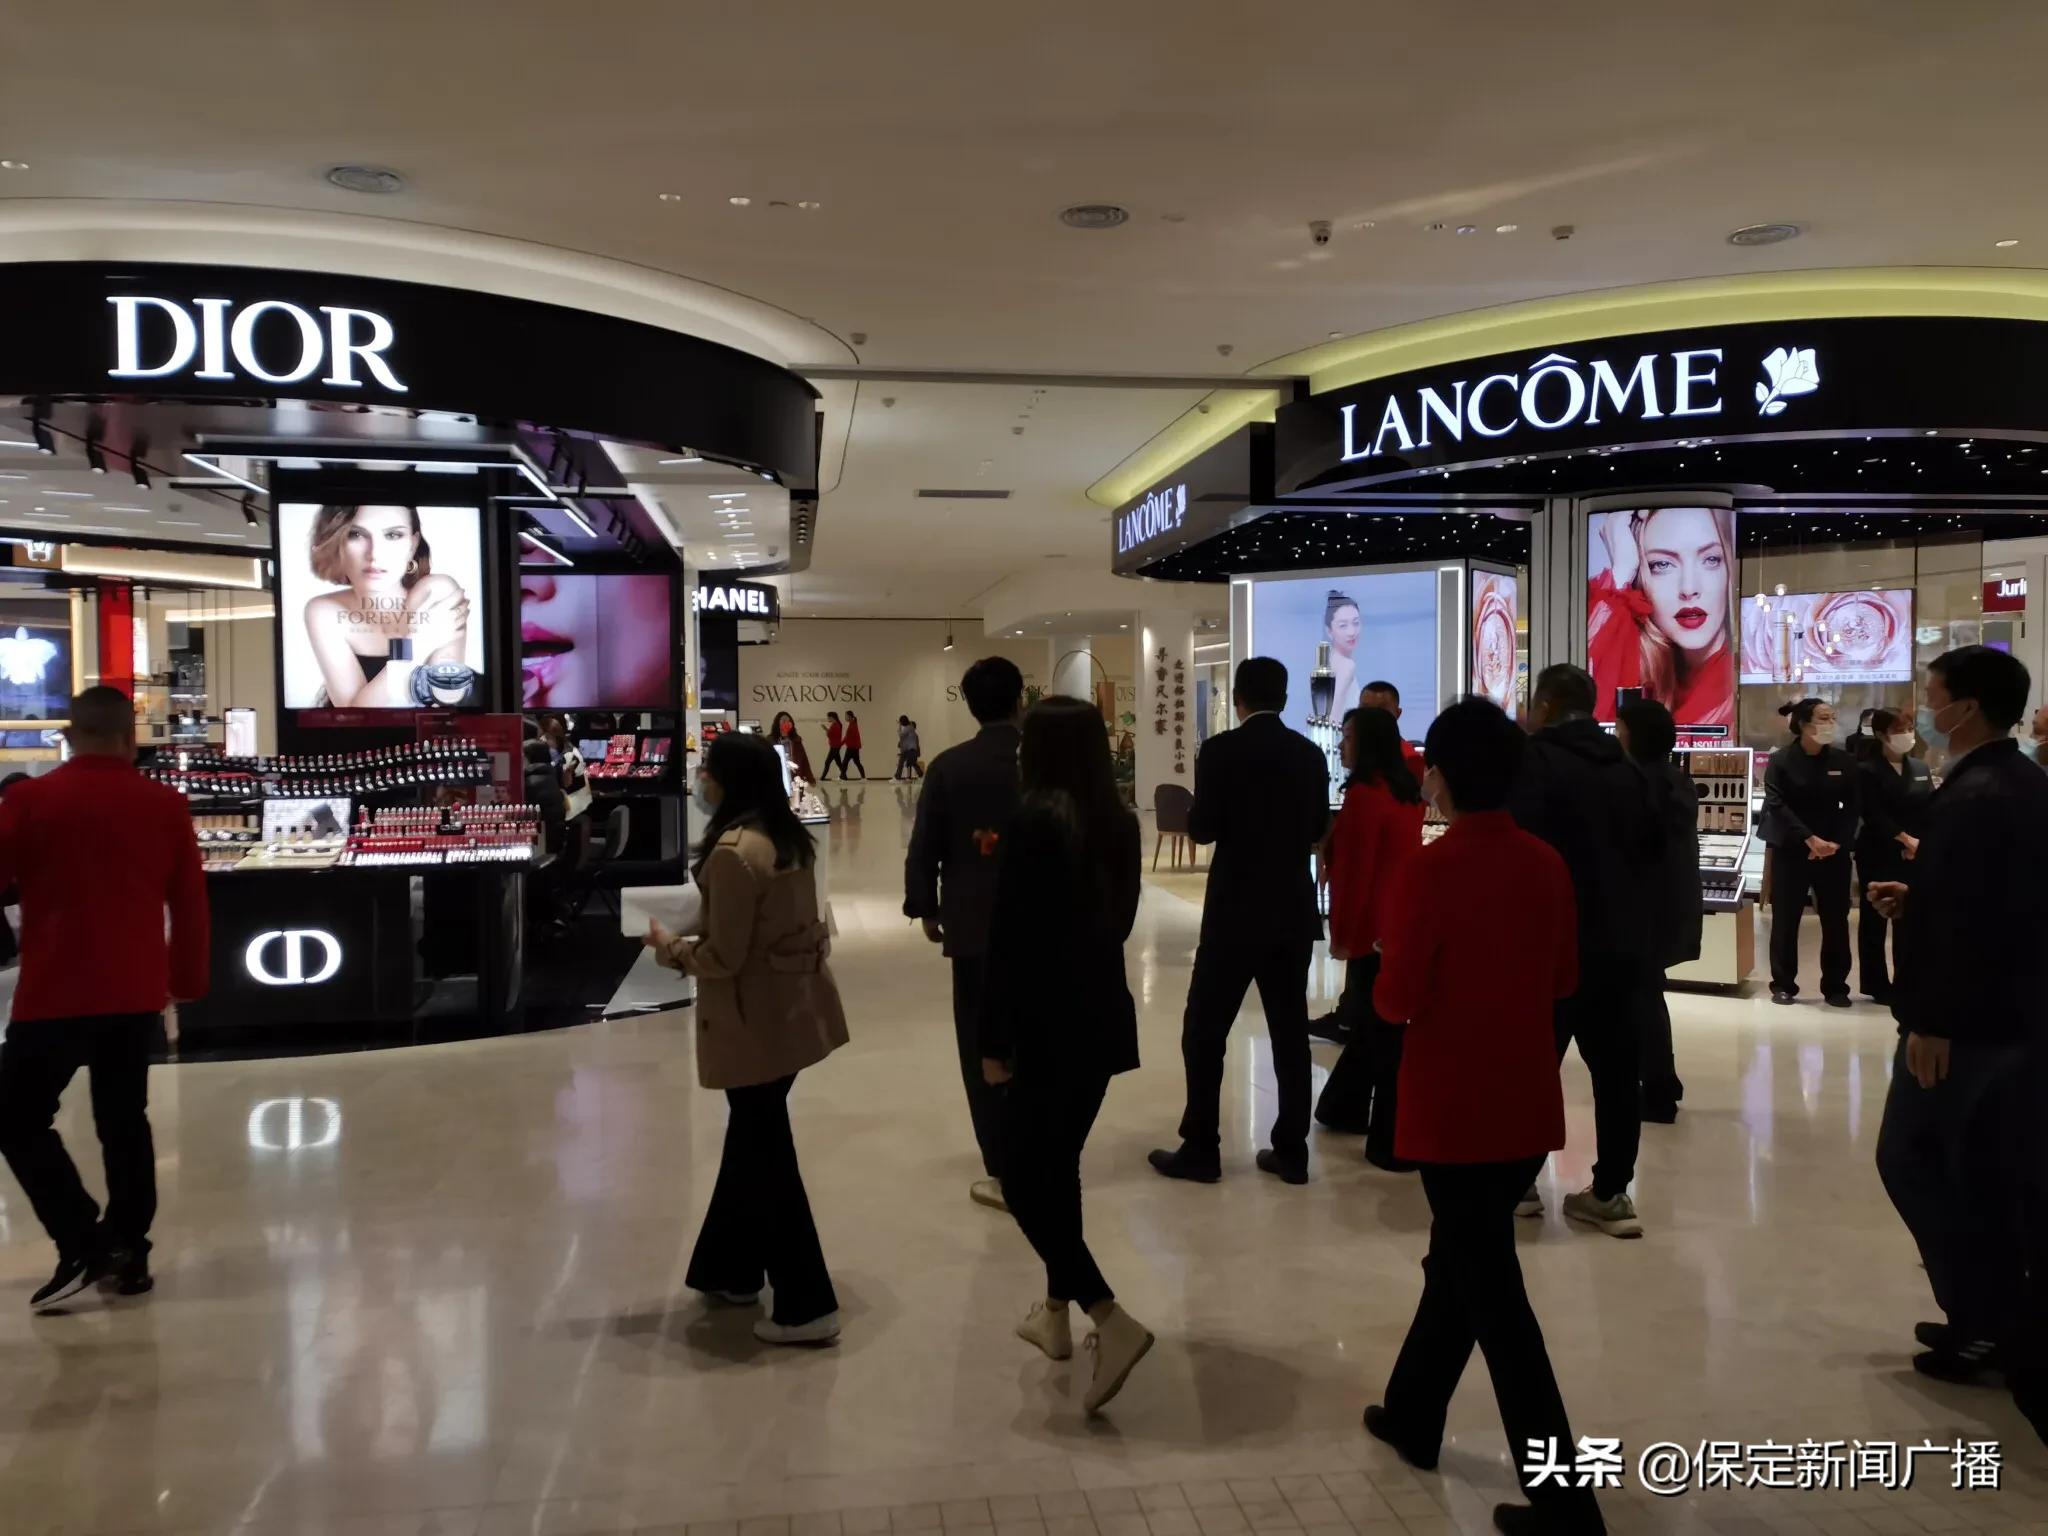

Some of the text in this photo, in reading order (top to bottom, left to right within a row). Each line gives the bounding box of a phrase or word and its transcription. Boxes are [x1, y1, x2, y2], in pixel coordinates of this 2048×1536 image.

[106, 295, 408, 392] DIOR
[1340, 348, 1723, 462] LANCÔME
[1118, 487, 1174, 553] LANCÔME
[337, 610, 430, 625] FOREVER
[360, 596, 408, 610] DIOR
[752, 685, 872, 702] SWAROVSKI
